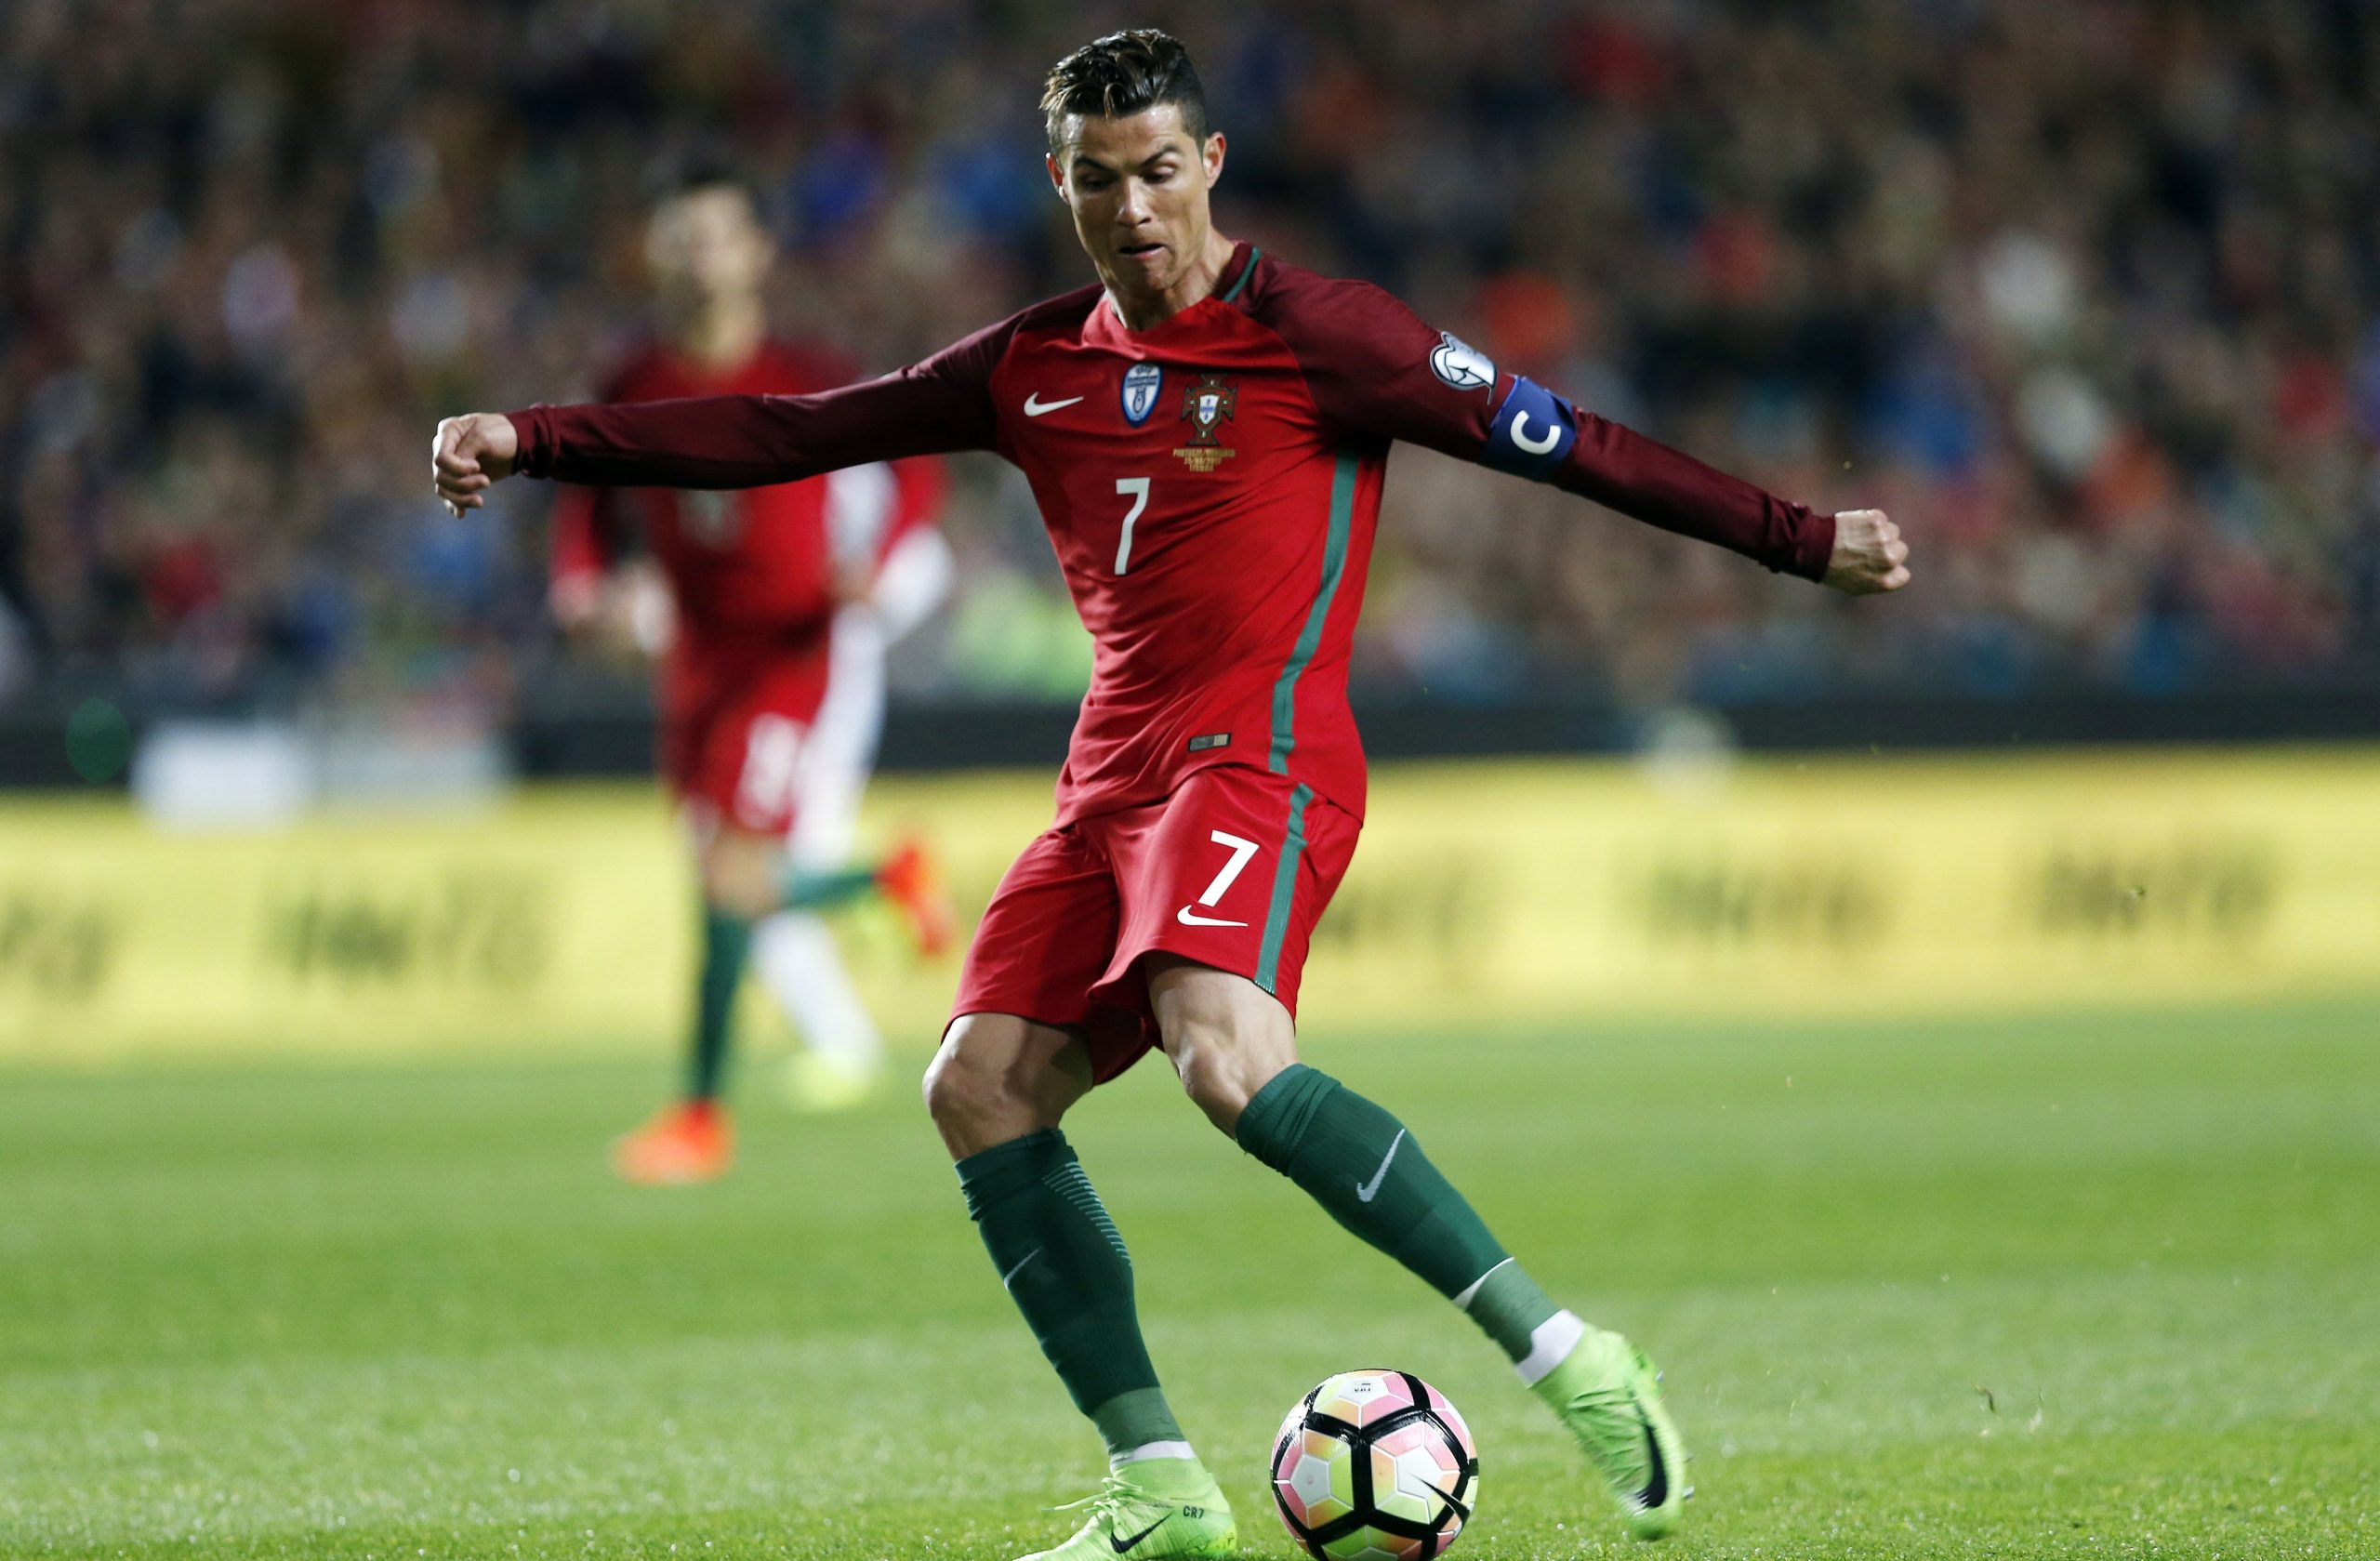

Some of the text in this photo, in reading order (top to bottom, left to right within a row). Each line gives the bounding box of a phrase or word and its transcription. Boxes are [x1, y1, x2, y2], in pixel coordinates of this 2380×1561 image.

[1510, 409, 1562, 455] C
[1115, 476, 1151, 575] 7
[1197, 828, 1260, 907] 7
[1183, 1505, 1205, 1519] CR7
